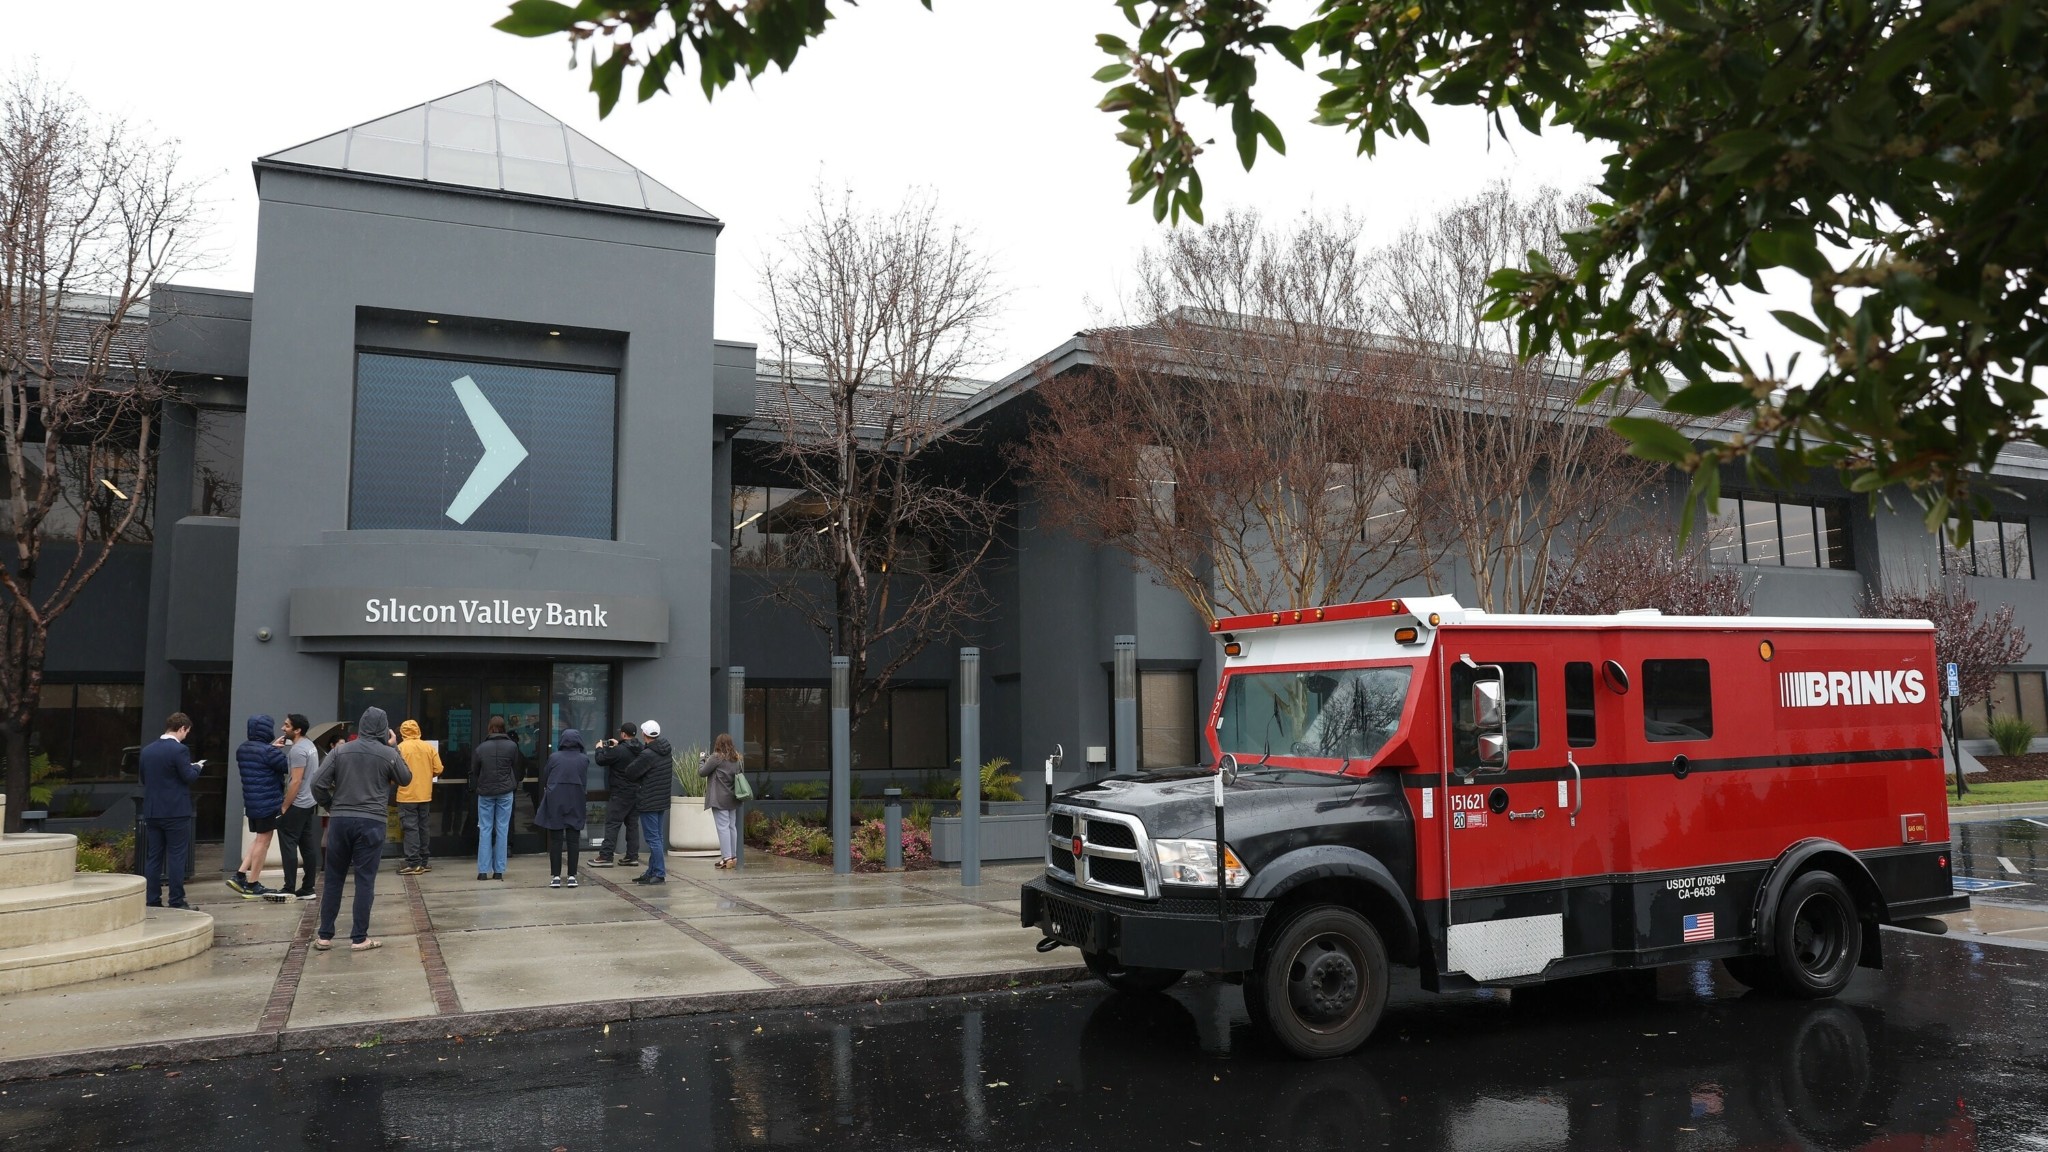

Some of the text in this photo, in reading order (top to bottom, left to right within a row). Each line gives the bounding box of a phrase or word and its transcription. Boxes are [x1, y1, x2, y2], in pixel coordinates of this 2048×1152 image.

[365, 598, 608, 631] Silicon Valley Bank
[572, 687, 593, 696] 3003
[1805, 669, 1926, 707] BRINKS
[1210, 674, 1228, 727] 1621
[1450, 793, 1485, 811] 151621
[1454, 815, 1465, 828] 20
[1666, 874, 1726, 890] USDOT 076054
[1678, 886, 1716, 900] CA-6436
